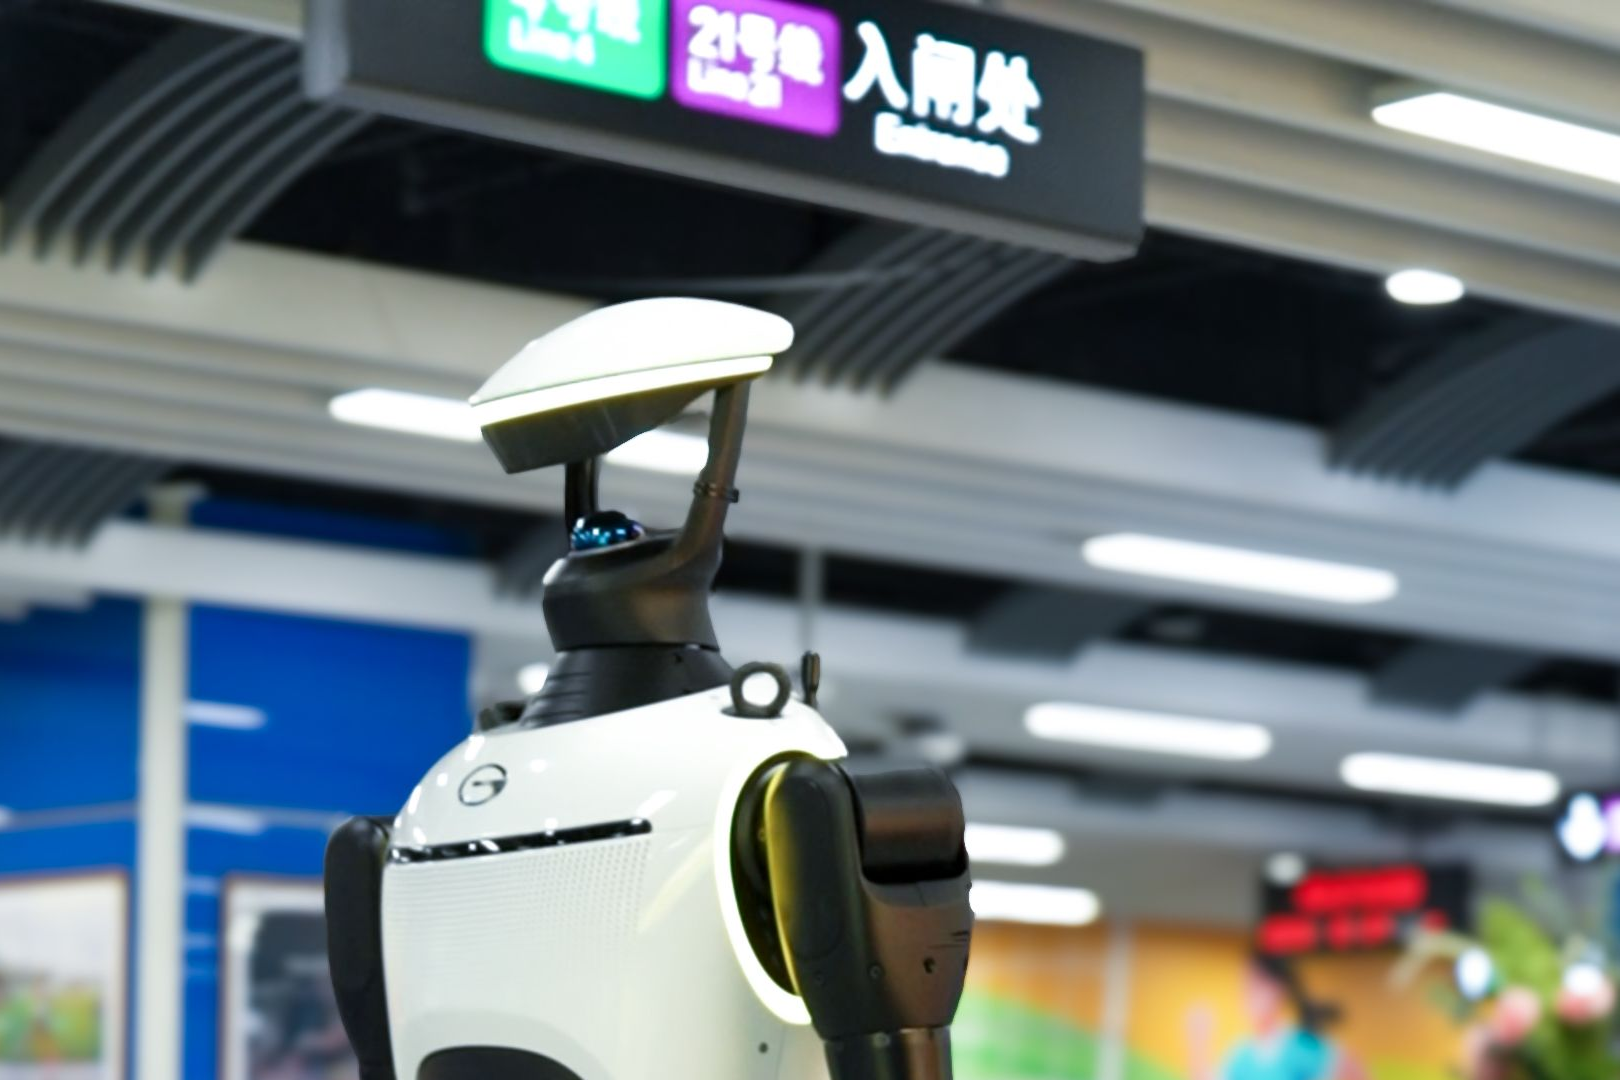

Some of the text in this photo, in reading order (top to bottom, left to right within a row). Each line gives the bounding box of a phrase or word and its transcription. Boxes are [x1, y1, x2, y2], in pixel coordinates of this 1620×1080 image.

[687, 5, 826, 86] 21号线
[843, 20, 1042, 144] 入闸处
